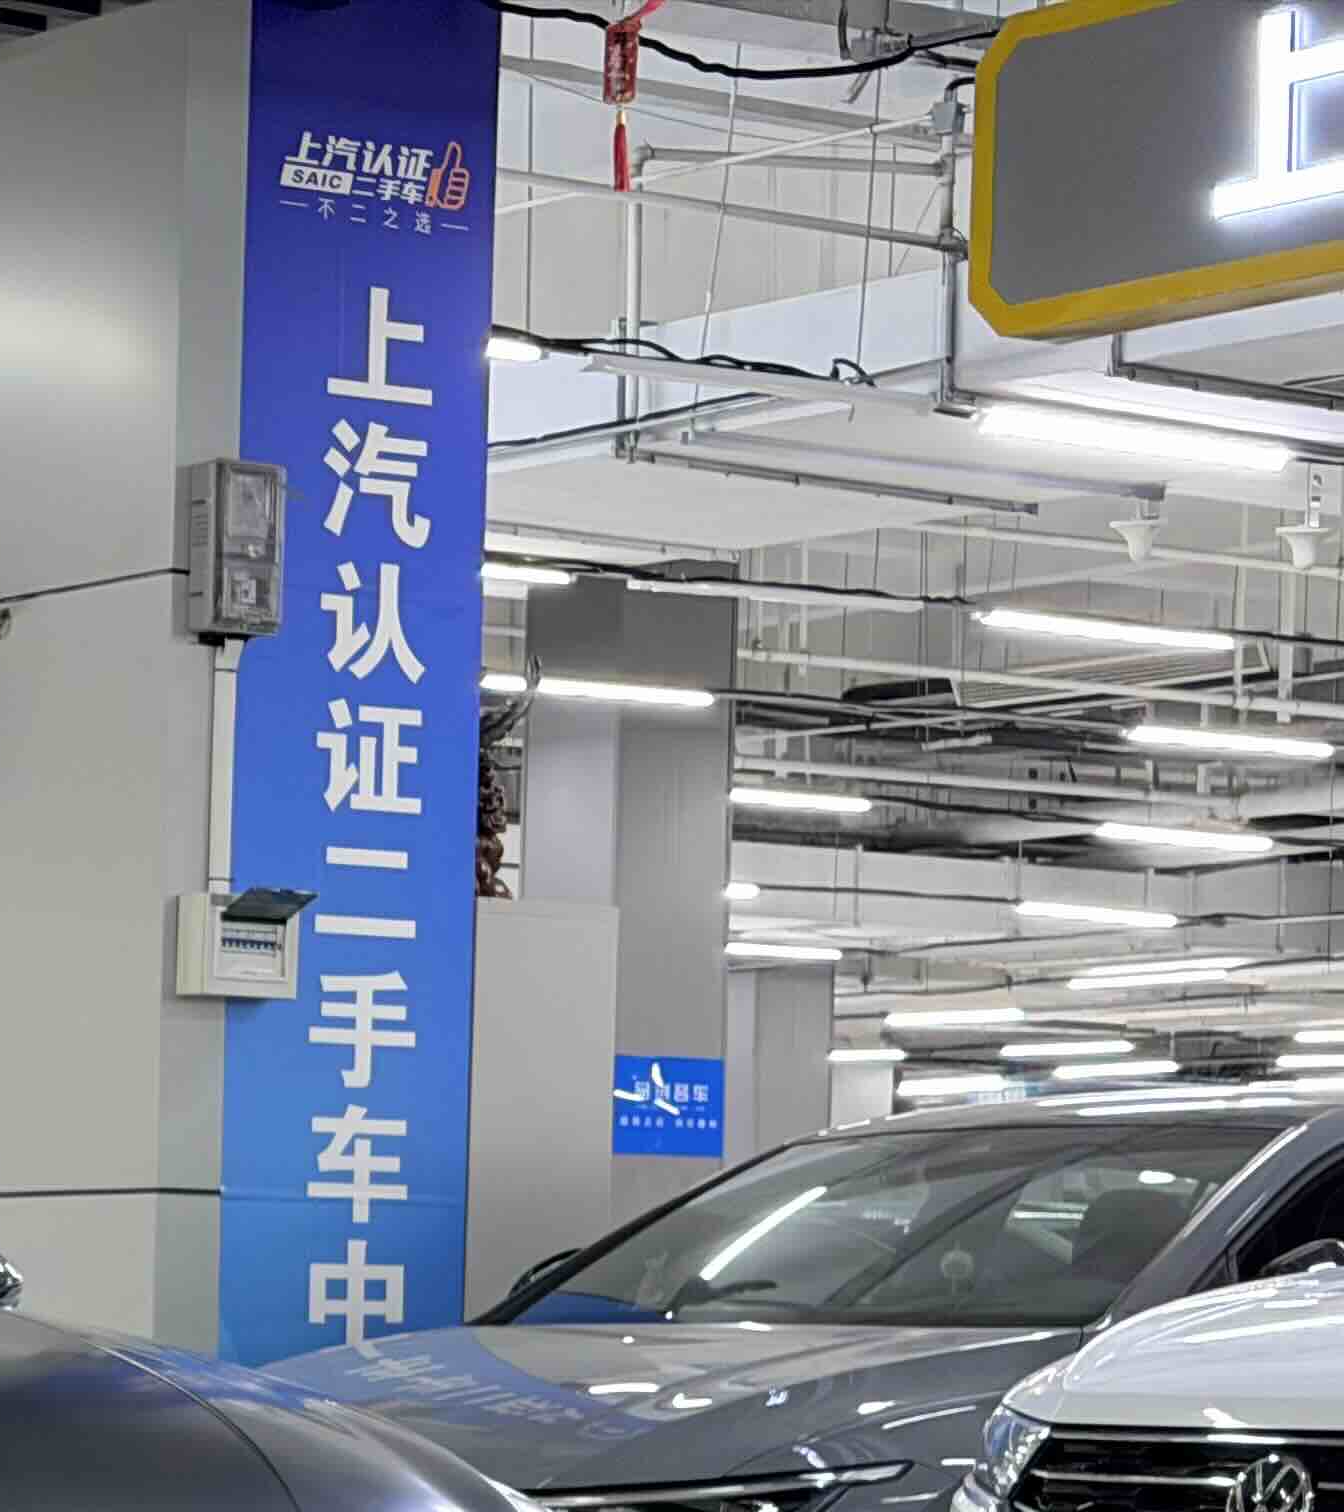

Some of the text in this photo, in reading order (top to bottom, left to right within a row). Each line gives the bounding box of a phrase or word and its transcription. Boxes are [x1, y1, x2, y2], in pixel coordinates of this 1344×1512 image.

[285, 131, 433, 180] 上汽认证
[291, 168, 426, 205] SAIC 二手车
[317, 196, 432, 235] 不二之选
[307, 286, 433, 1346] 上汽认证二手车中
